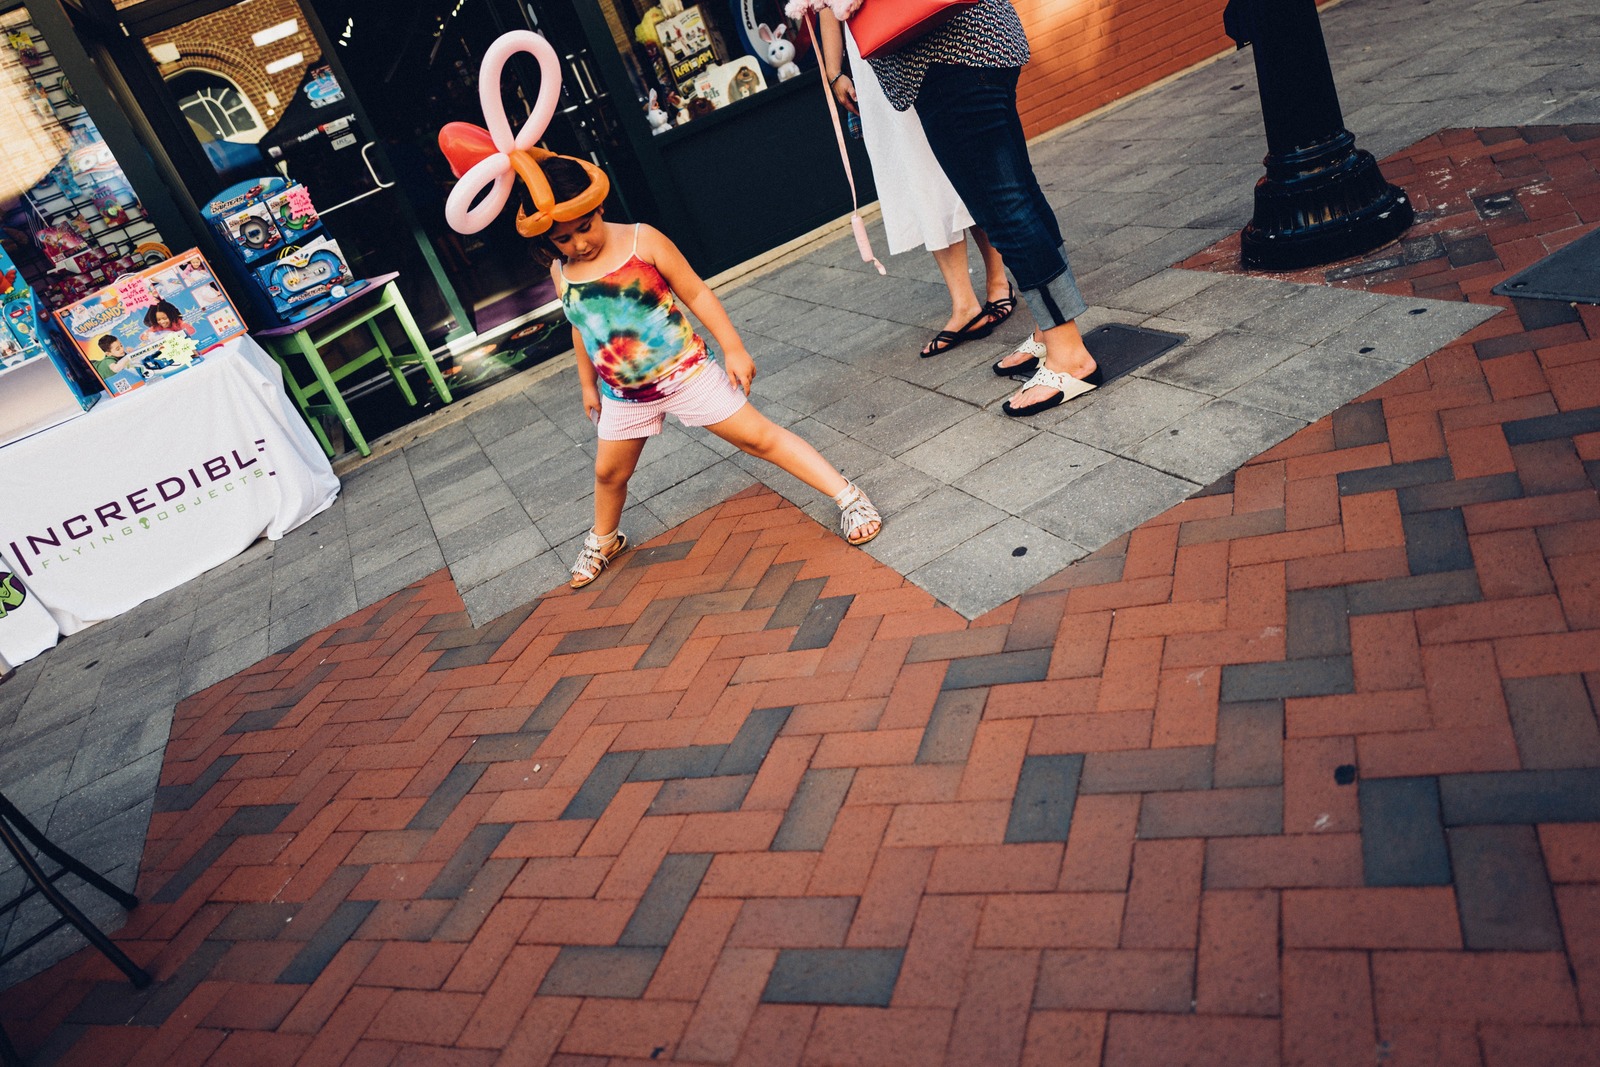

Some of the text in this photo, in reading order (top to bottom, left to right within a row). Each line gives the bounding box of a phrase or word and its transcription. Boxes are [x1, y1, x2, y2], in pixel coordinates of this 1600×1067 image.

[95, 301, 126, 326] SANDS
[41, 467, 265, 570] FLYING OBJECTS
